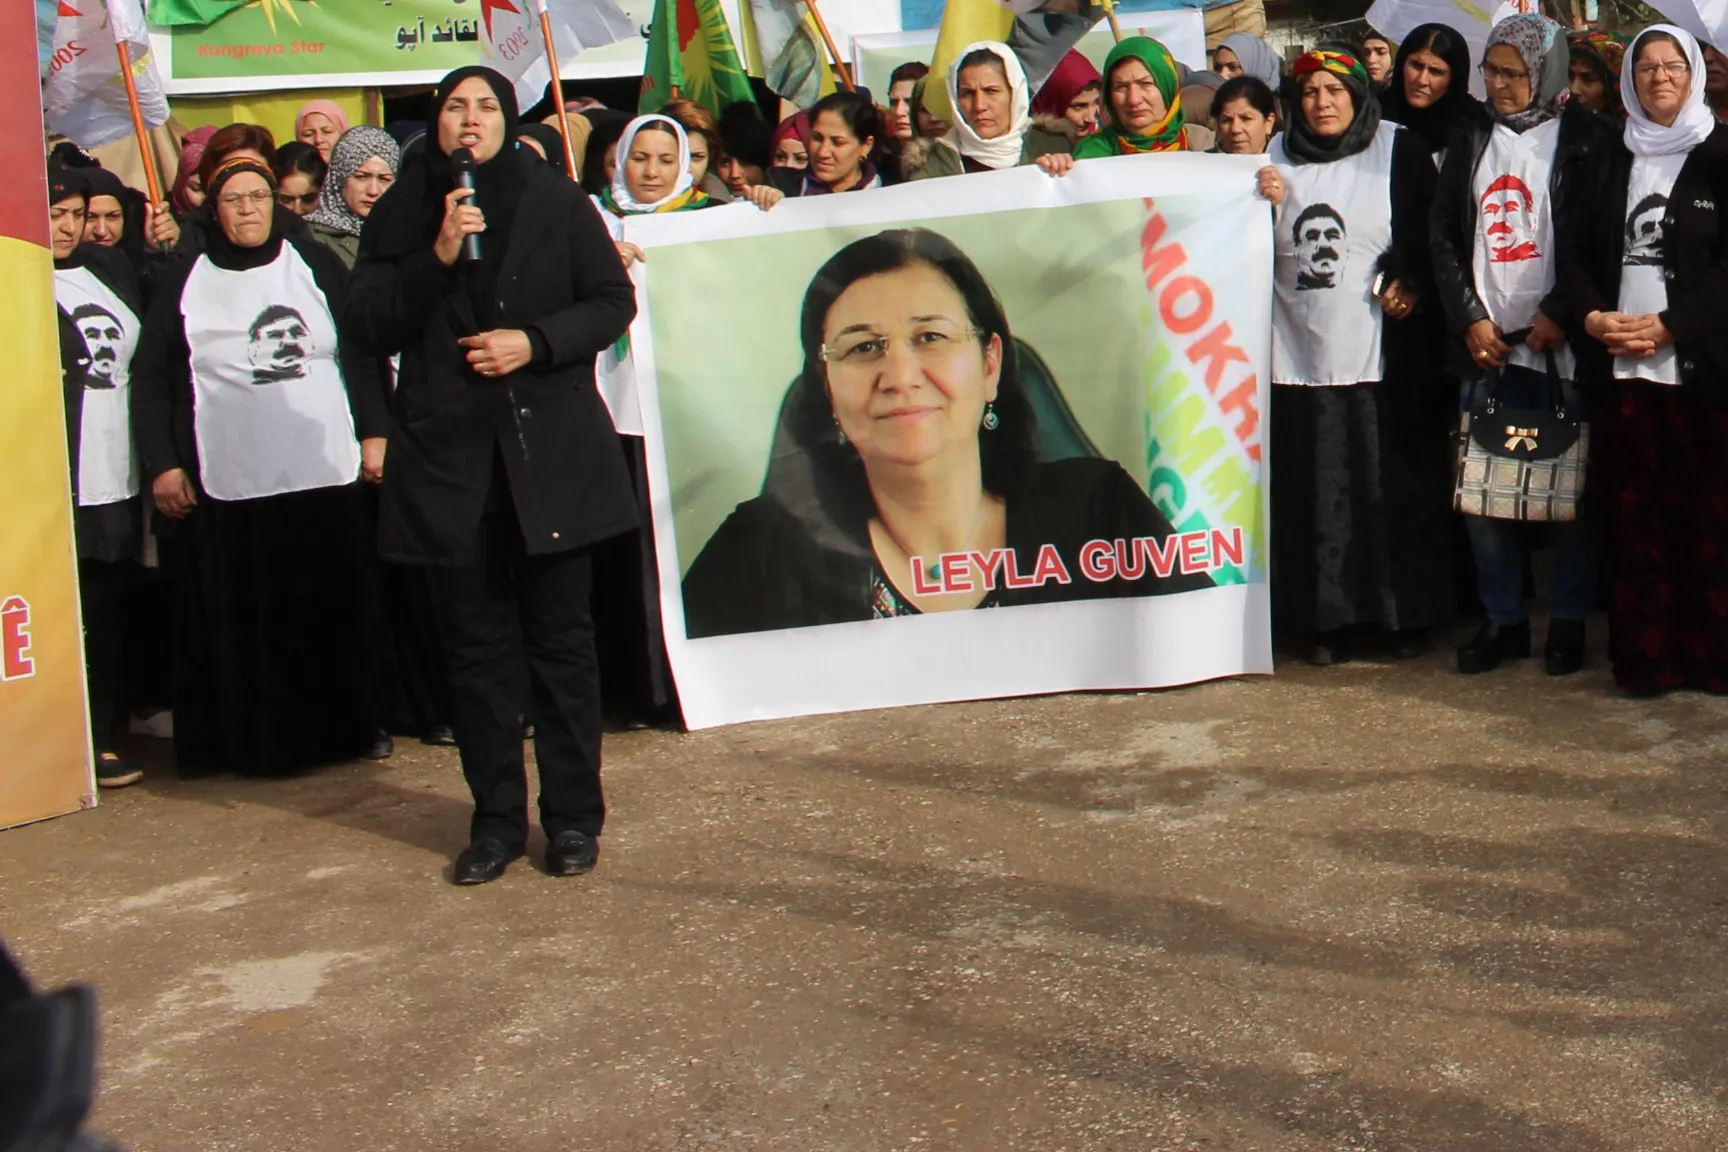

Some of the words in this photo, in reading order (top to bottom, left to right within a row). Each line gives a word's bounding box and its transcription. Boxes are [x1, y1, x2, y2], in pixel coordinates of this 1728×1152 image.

[291, 40, 325, 54] Star
[910, 542, 1072, 597] LEYLA
[1078, 527, 1246, 583] GUVEN
